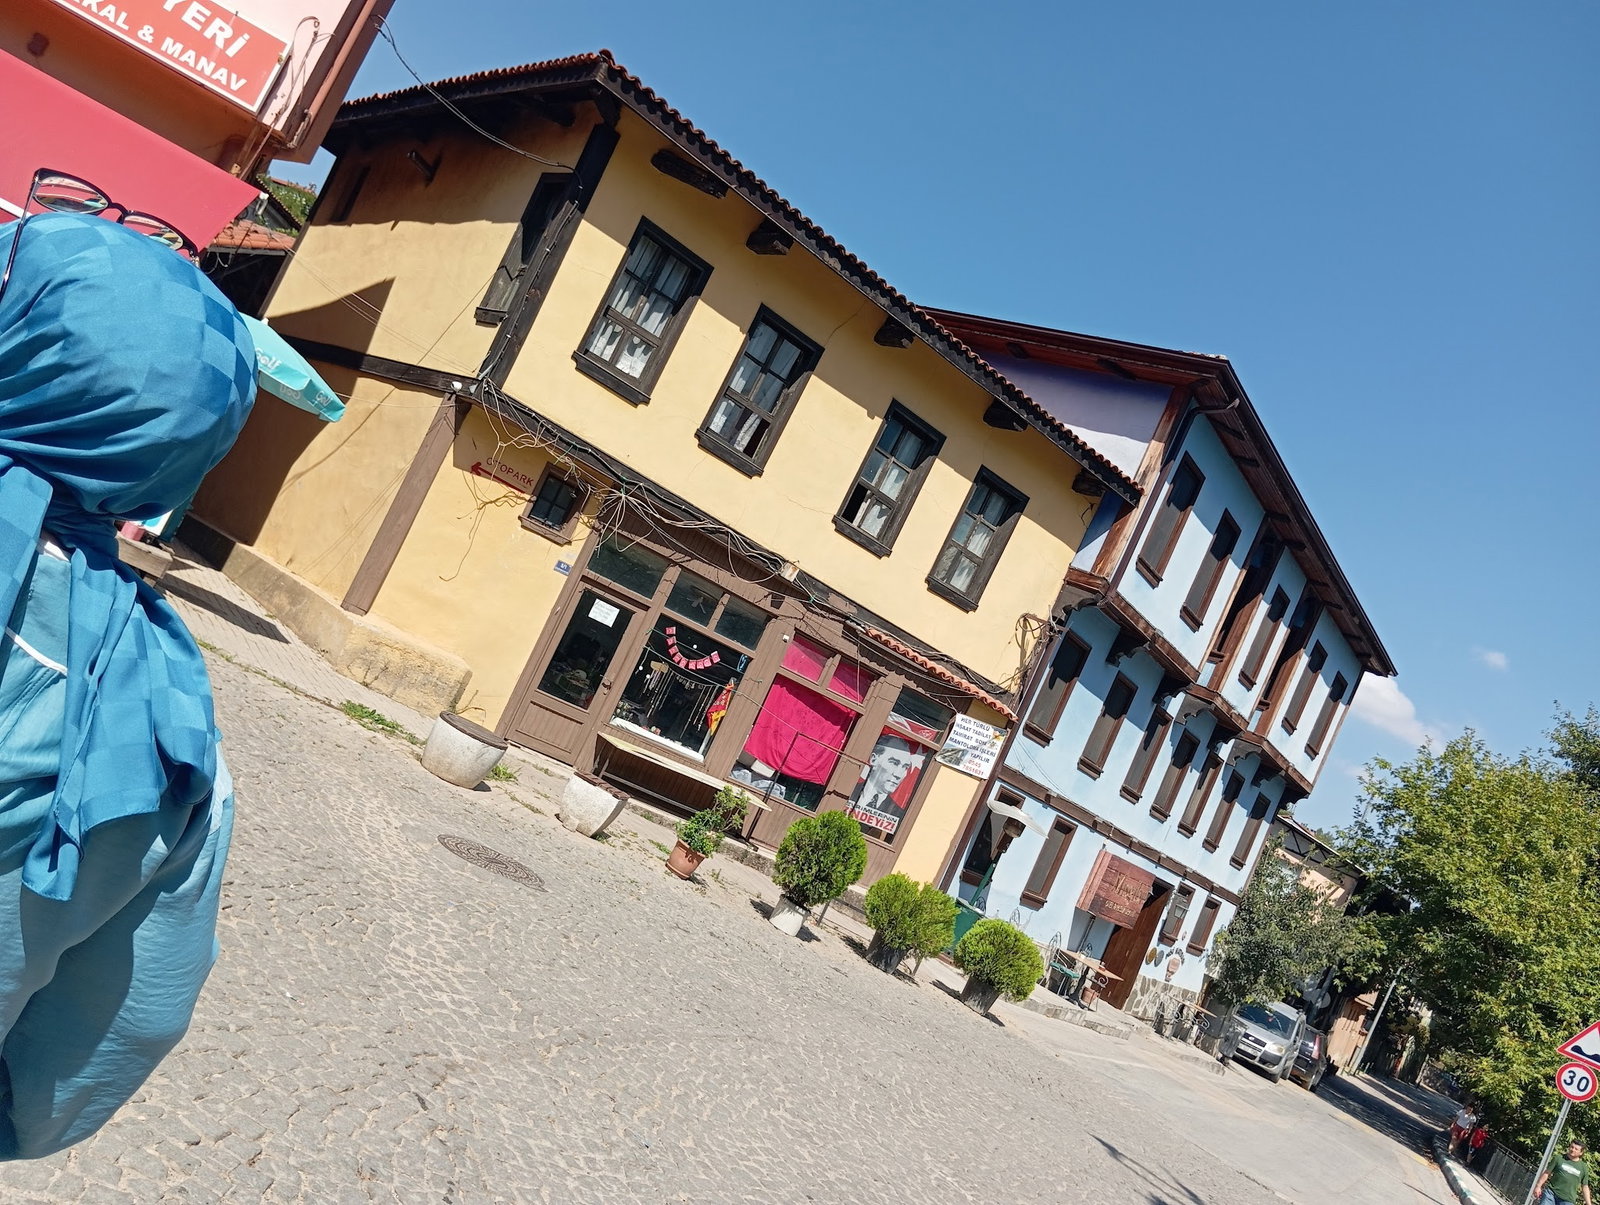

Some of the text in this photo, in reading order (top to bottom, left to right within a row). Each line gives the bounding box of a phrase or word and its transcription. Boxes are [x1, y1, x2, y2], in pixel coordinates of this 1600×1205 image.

[70, 0, 248, 92] KAL & MANAV
[486, 457, 535, 487] OTOPARK
[1563, 1069, 1590, 1092] 30
